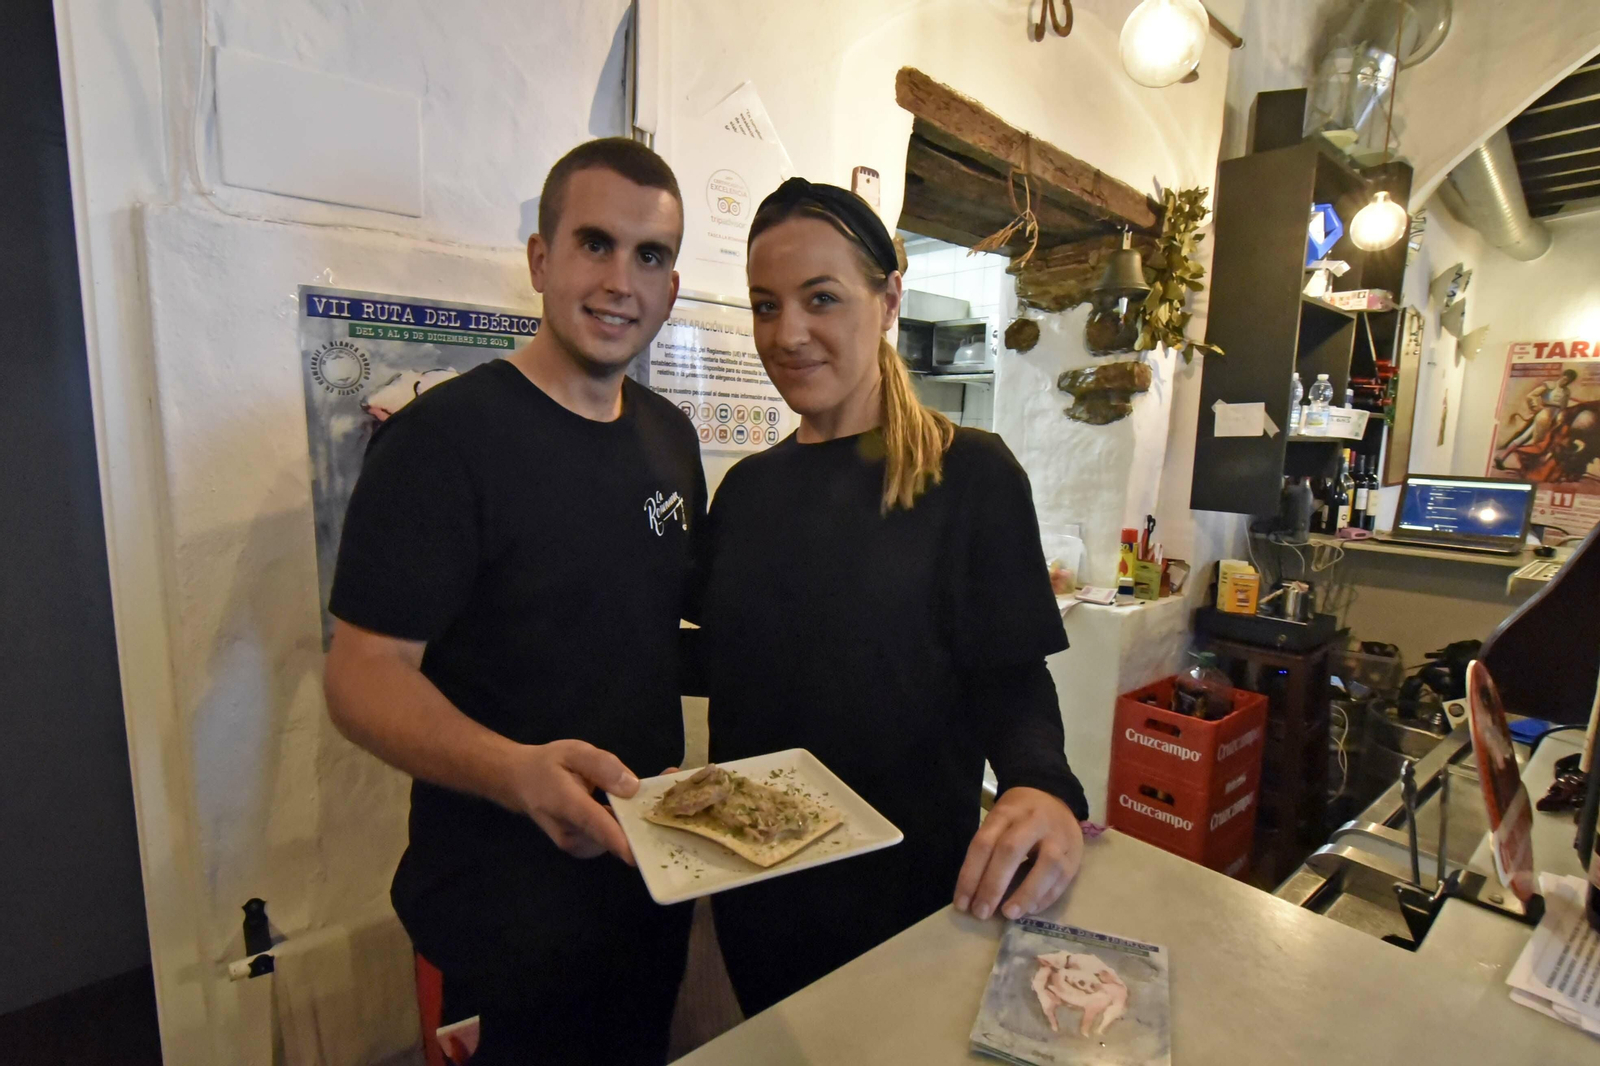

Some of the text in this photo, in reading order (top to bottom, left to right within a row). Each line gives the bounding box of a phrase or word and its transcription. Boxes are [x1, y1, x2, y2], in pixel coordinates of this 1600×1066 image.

[710, 183, 748, 197] EXCELENCIA
[313, 297, 539, 334] VII RUTA DEL IBÉRICO
[666, 317, 723, 333] DECLARACIÓN
[724, 324, 734, 335] DE
[355, 326, 509, 347] DEL 5 AL 9 DE DICIEMBRE DE 2019
[1125, 728, 1200, 762] Cruzcampo
[1119, 794, 1193, 831] Cruzcampo
[1019, 918, 1036, 927] VII
[1042, 923, 1071, 934] RUTA
